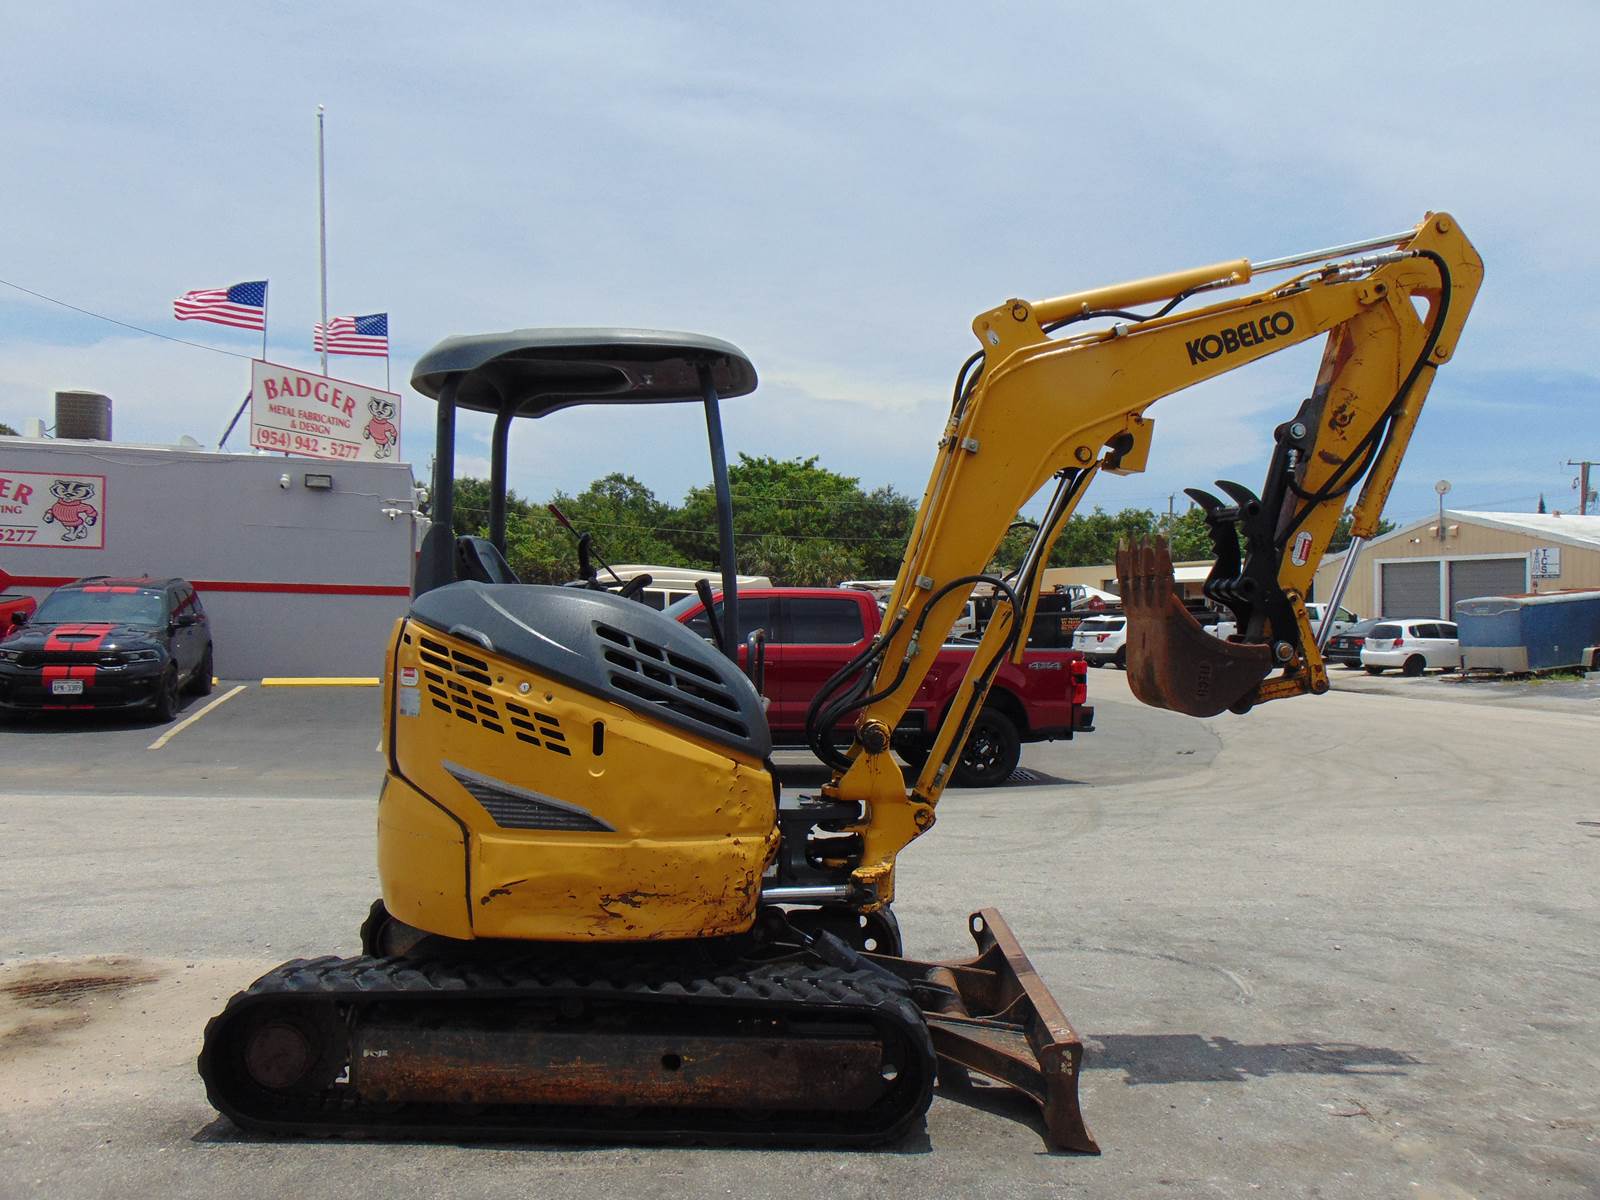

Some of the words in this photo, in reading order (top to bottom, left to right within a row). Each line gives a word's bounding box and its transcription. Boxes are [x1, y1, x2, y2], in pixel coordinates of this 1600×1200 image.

[1185, 311, 1294, 366] KOBELCO
[263, 376, 357, 417] BADGER
[269, 403, 296, 417] METAL
[298, 409, 350, 428] FABRICATING
[290, 420, 297, 429] &
[299, 422, 331, 435] DESIGN
[257, 427, 291, 448] (954)
[294, 435, 319, 453] 942
[330, 441, 361, 459] 5277
